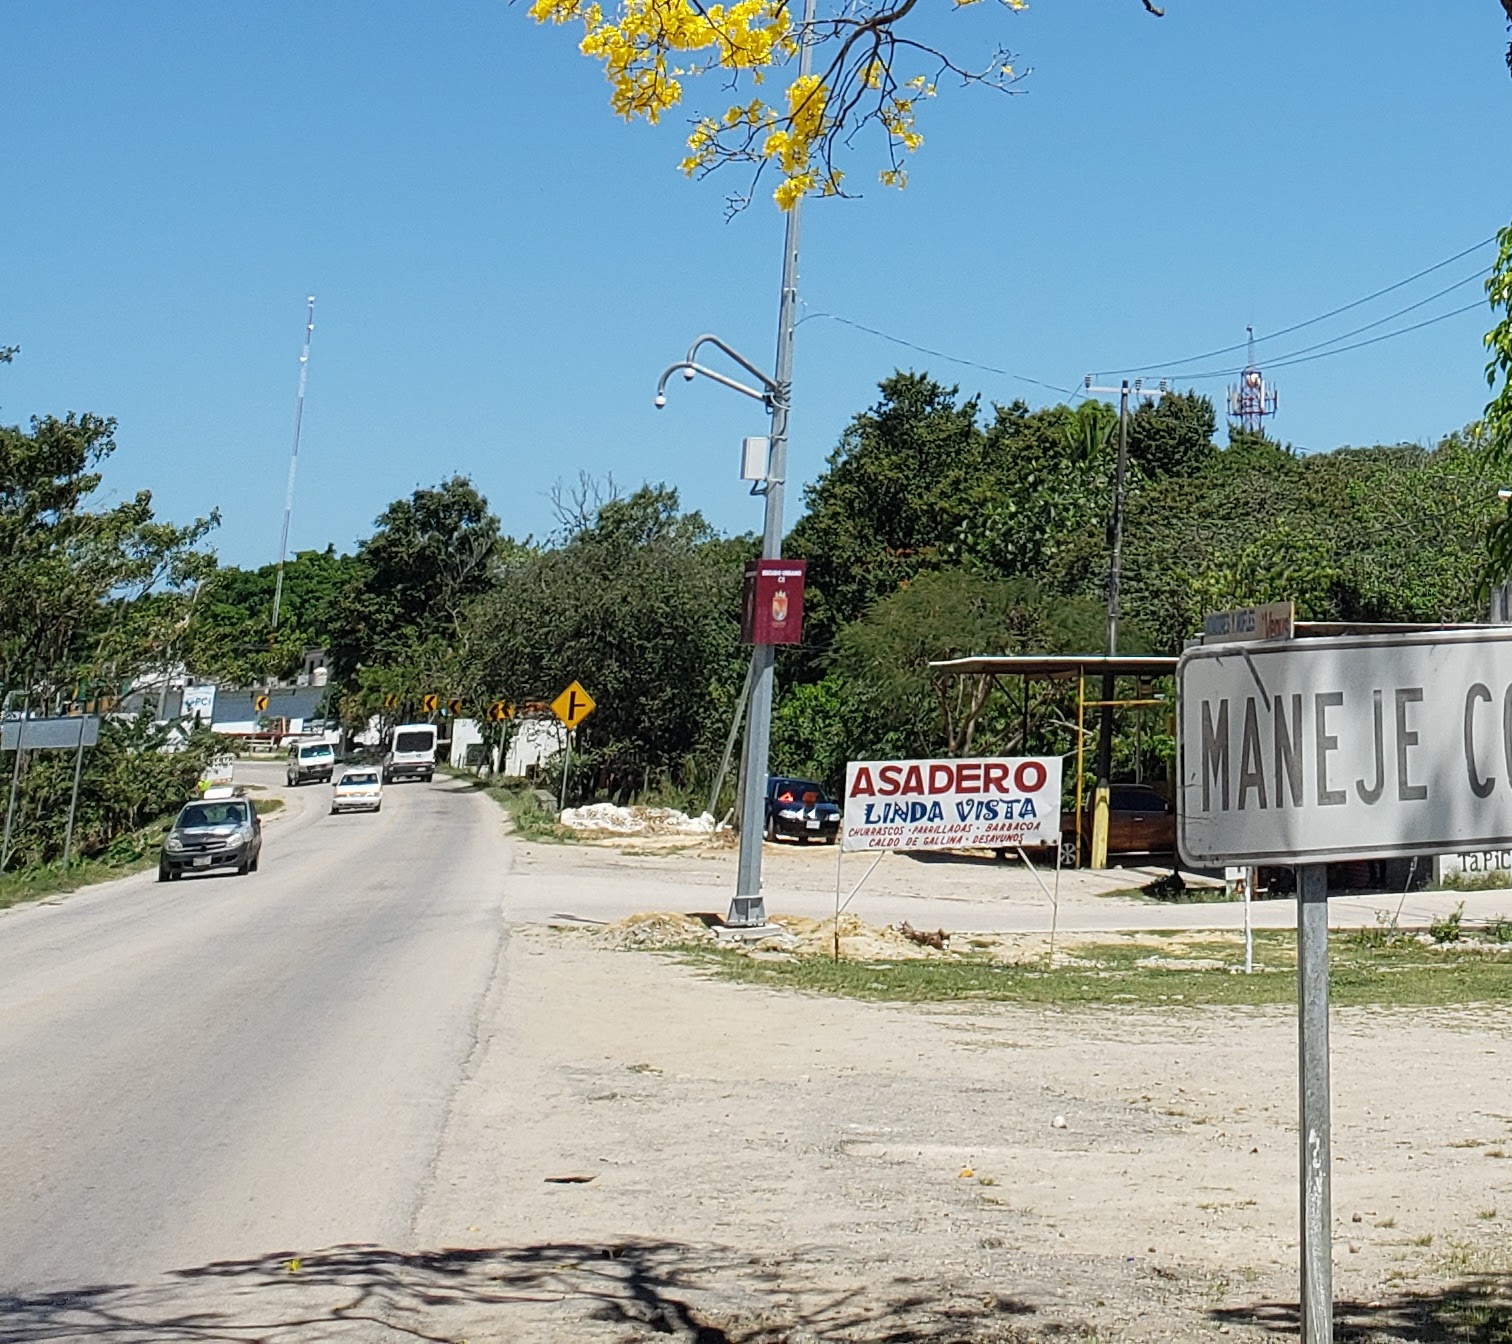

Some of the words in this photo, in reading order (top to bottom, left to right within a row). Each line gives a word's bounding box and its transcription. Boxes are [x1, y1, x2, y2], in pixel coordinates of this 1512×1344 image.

[1201, 688, 1428, 812] MANEJE
[849, 761, 1047, 798] ASADERO
[864, 801, 944, 824] LINDA
[955, 798, 1038, 822] VISTA
[848, 826, 905, 838] CHURRASCOS
[911, 823, 973, 835] PARRILLADAS
[985, 821, 1041, 832] BARBACOA
[868, 838, 901, 848] CALDO
[905, 836, 919, 846] DE
[923, 835, 963, 845] GALLINA
[972, 833, 1024, 844] DESAYUNOS
